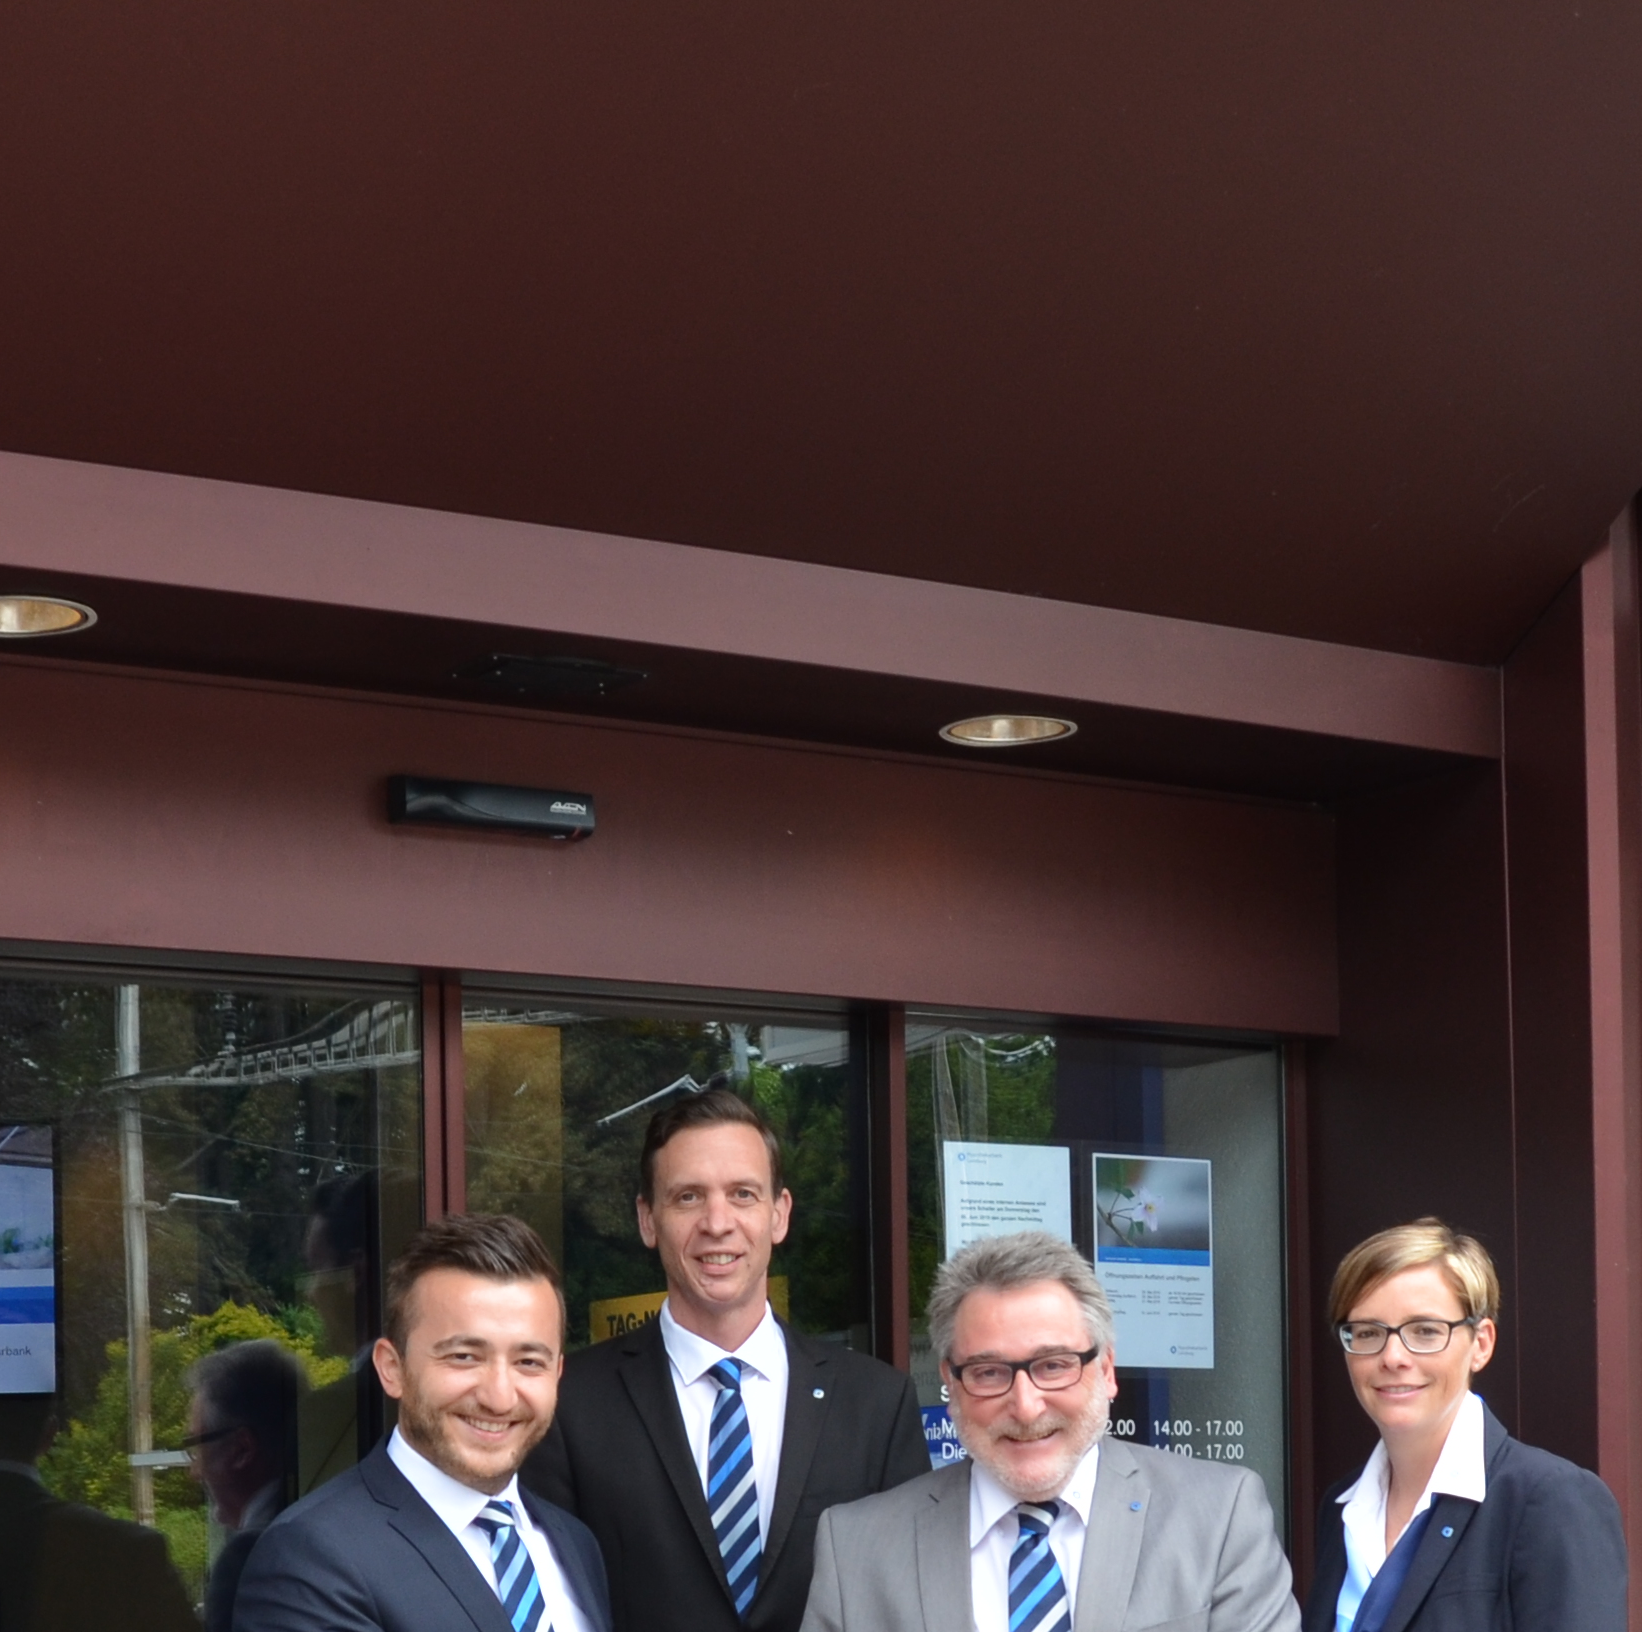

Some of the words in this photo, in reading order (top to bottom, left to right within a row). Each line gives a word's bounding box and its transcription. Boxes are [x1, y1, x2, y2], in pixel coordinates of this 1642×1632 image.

[1153, 1420, 1193, 1437] 14.00
[1205, 1420, 1244, 1437] 17.00
[1206, 1444, 1244, 1460] 17.00
